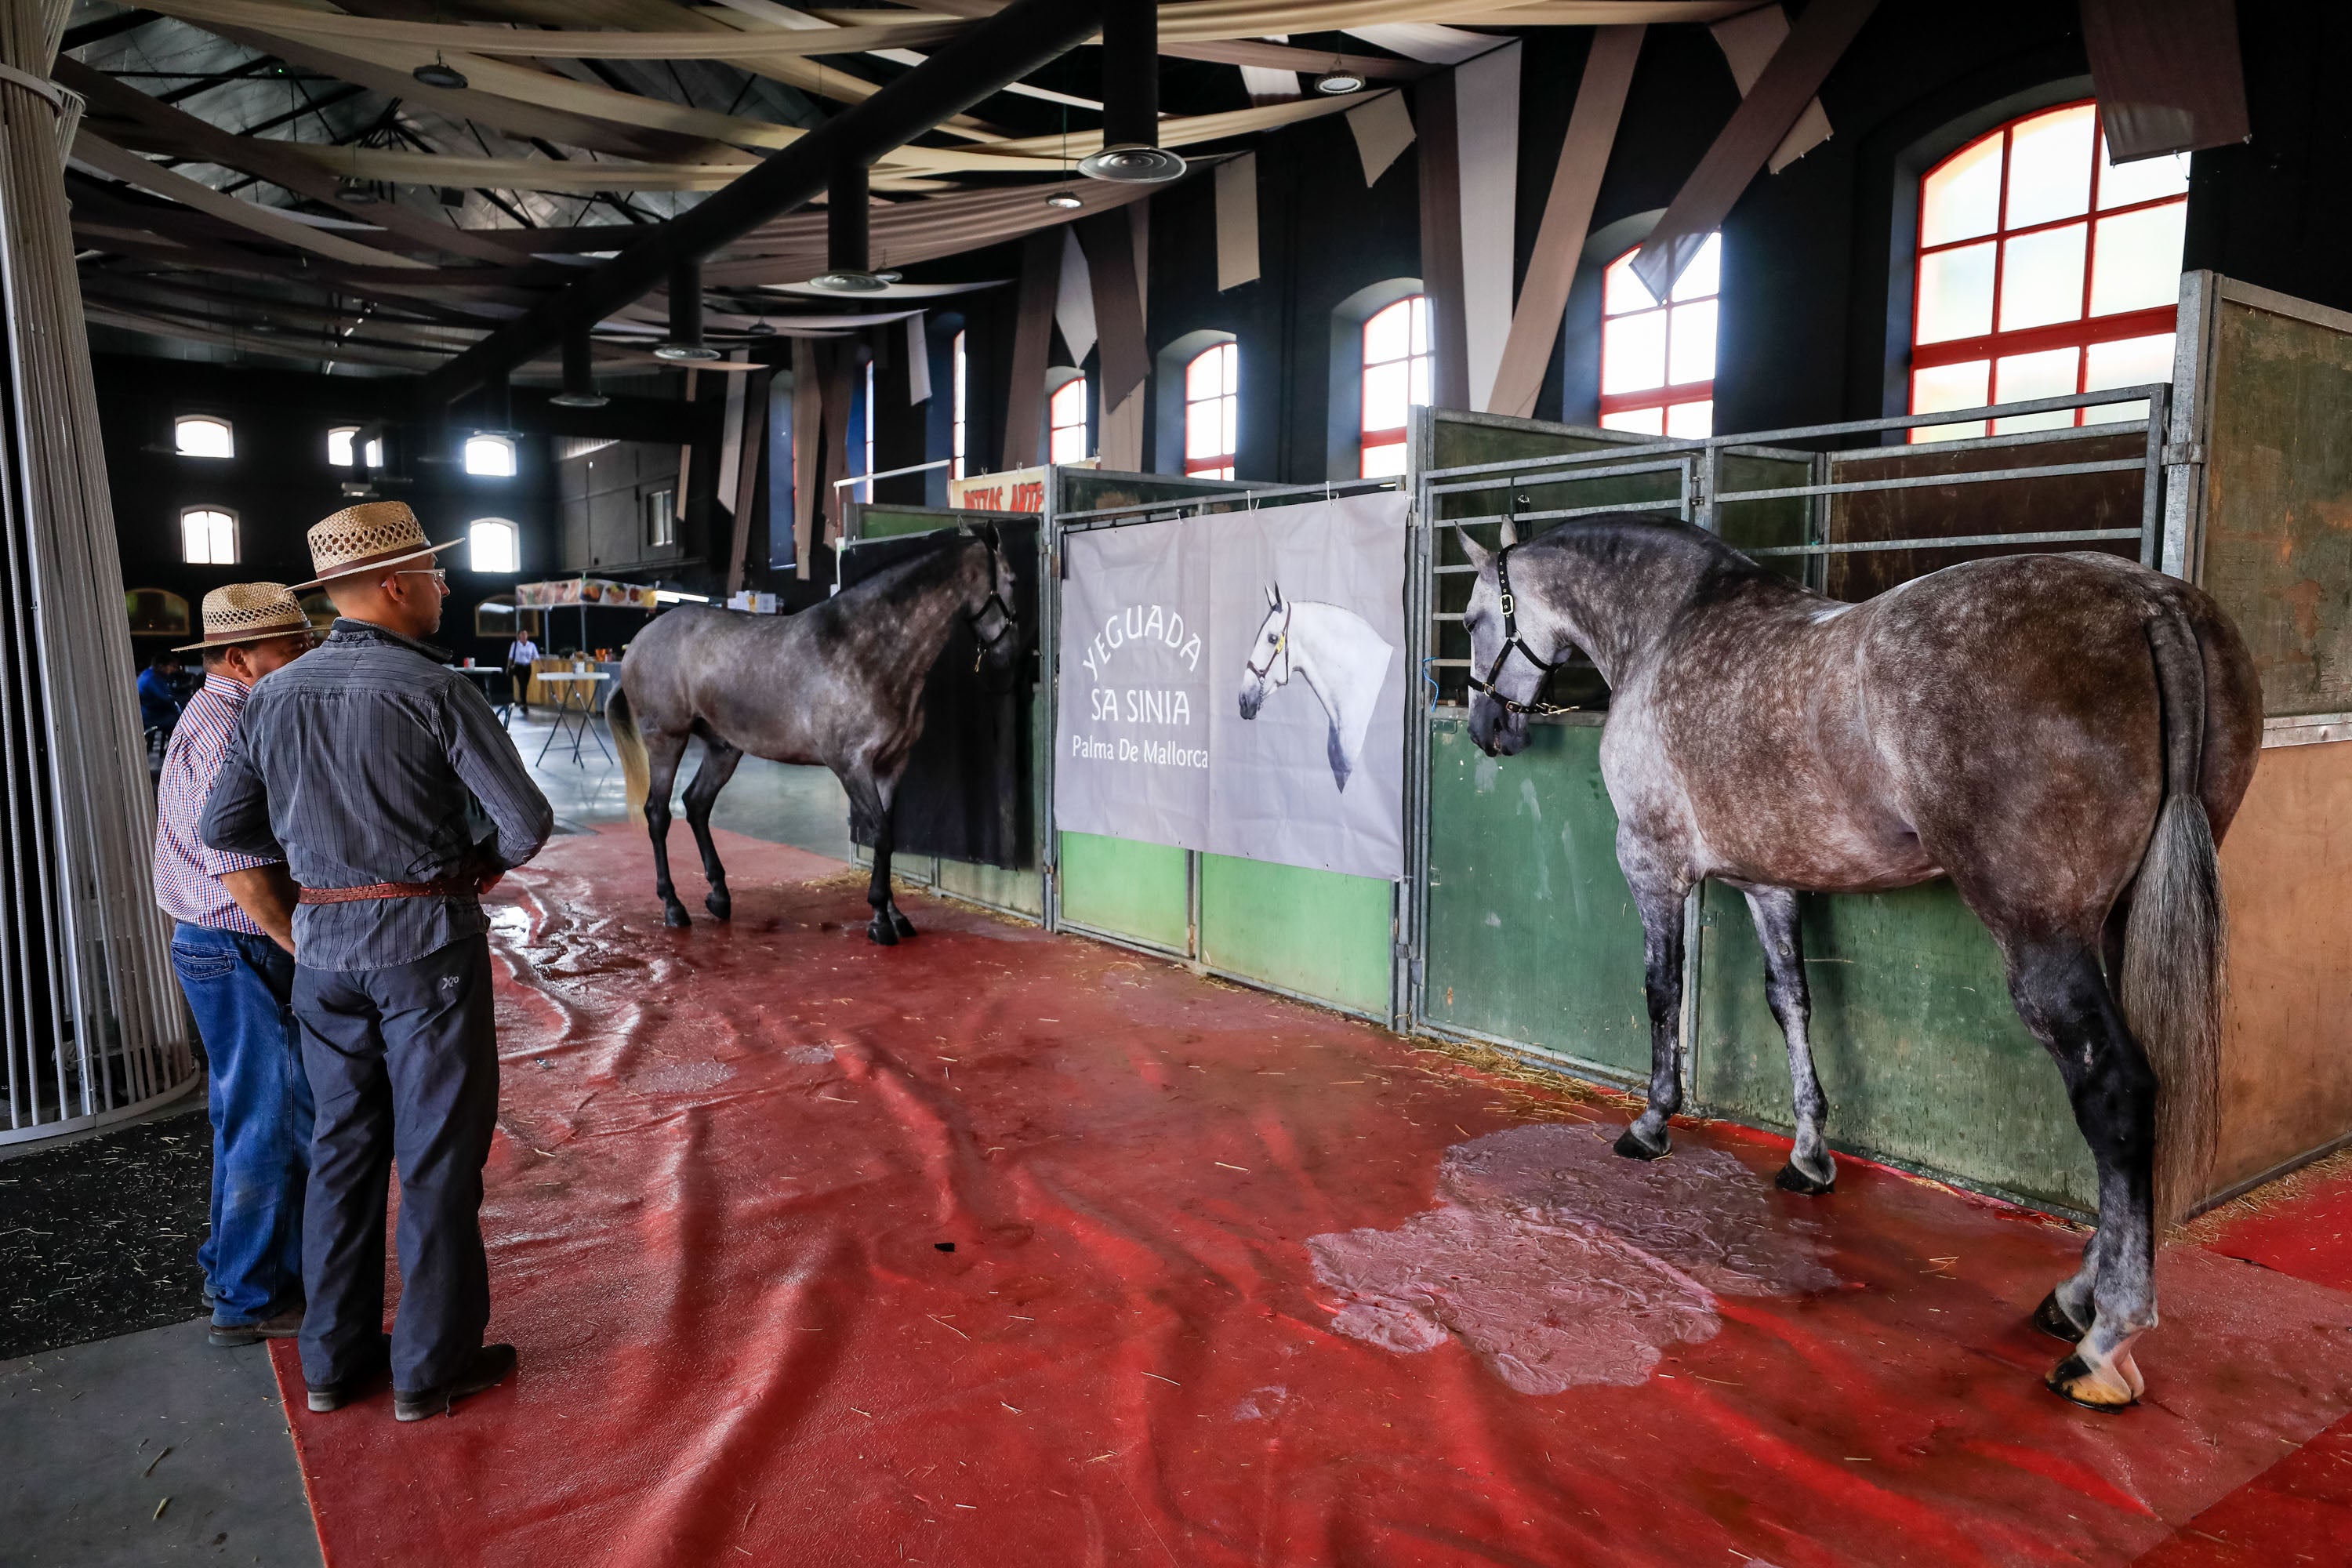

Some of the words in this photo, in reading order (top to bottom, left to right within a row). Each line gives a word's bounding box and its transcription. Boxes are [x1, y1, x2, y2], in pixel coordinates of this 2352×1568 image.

[1011, 481, 1044, 513] ARTE
[1082, 604, 1201, 682] YEGUADA
[1091, 688, 1119, 722] SA
[1126, 689, 1190, 725] SINIA
[1073, 734, 1115, 760] Palma
[1119, 738, 1140, 763] De
[1143, 739, 1208, 768] Mallorca
